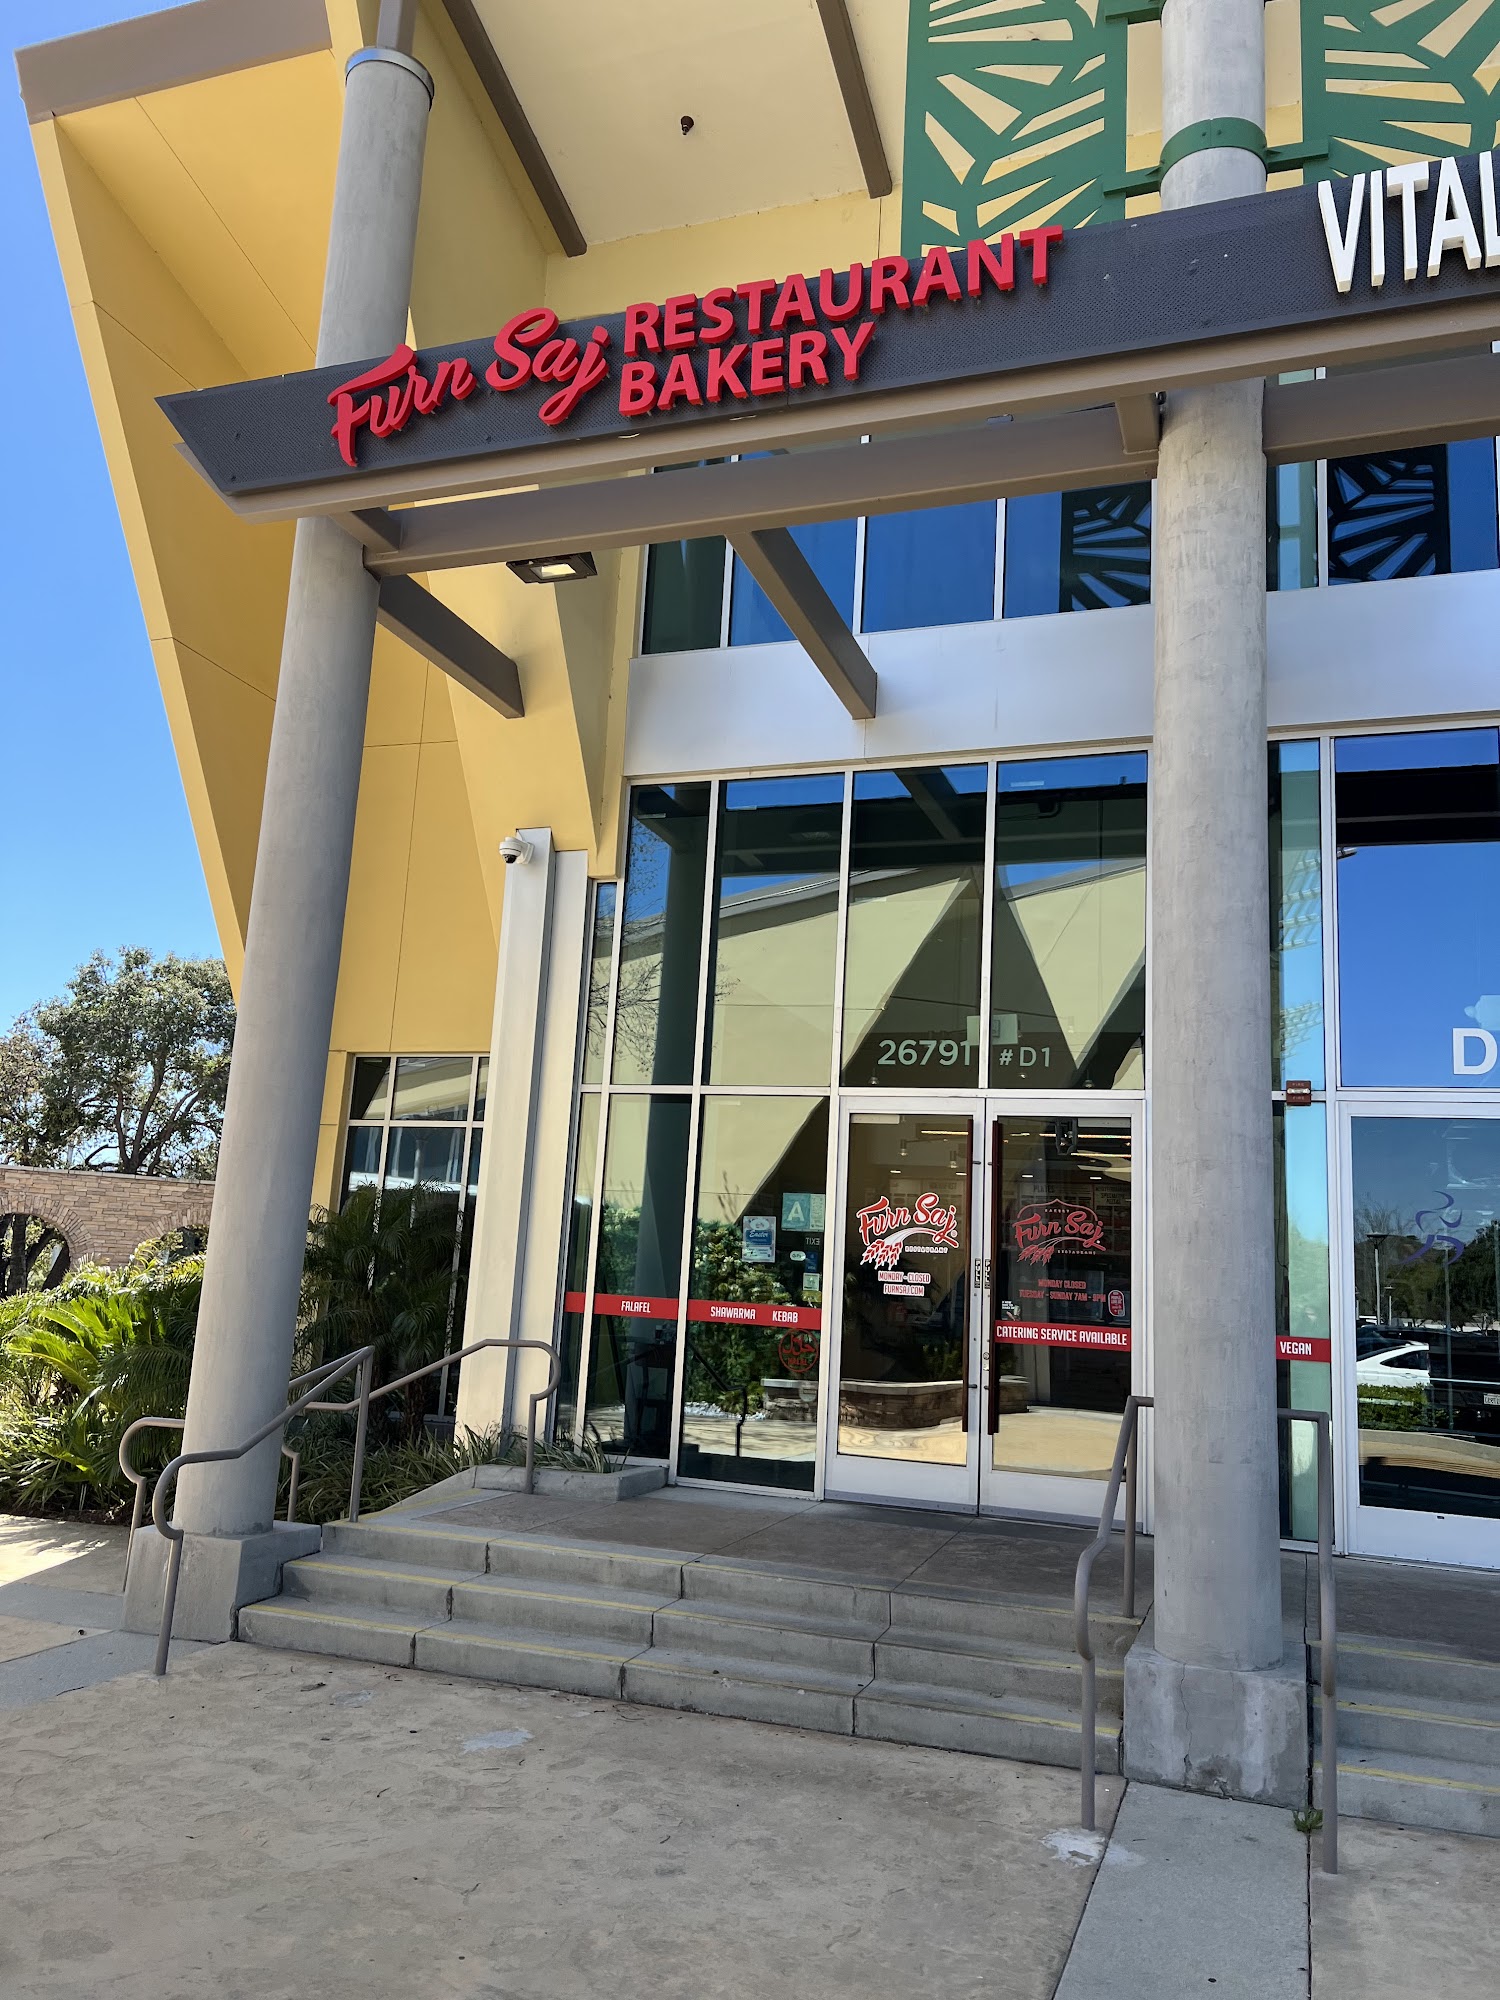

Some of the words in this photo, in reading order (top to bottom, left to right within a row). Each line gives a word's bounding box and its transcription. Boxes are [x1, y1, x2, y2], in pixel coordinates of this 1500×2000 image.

[1318, 151, 1500, 293] VITAL
[623, 225, 1063, 357] RESTAURANT
[618, 321, 875, 416] BAKERY
[328, 342, 474, 467] Furn
[485, 306, 611, 426] Saj
[878, 1040, 972, 1066] 26791
[787, 1201, 805, 1221] A
[856, 1196, 911, 1246] Furn
[913, 1193, 959, 1248] Saj
[1012, 1213, 1061, 1249] Furn
[1064, 1211, 1106, 1251] Saj
[878, 1271, 904, 1282] MONDAY
[907, 1272, 931, 1284] CLOSED
[883, 1284, 925, 1296] FURNSAJ.COM
[621, 1301, 651, 1313] FALAFEL
[710, 1306, 756, 1320] SHAWARMA
[772, 1310, 799, 1323] KEBAB
[996, 1325, 1038, 1340] CATERING
[1041, 1328, 1077, 1342] SERVICE
[1079, 1331, 1127, 1345] AVAILABLE
[1280, 1341, 1312, 1356] VEGAN
